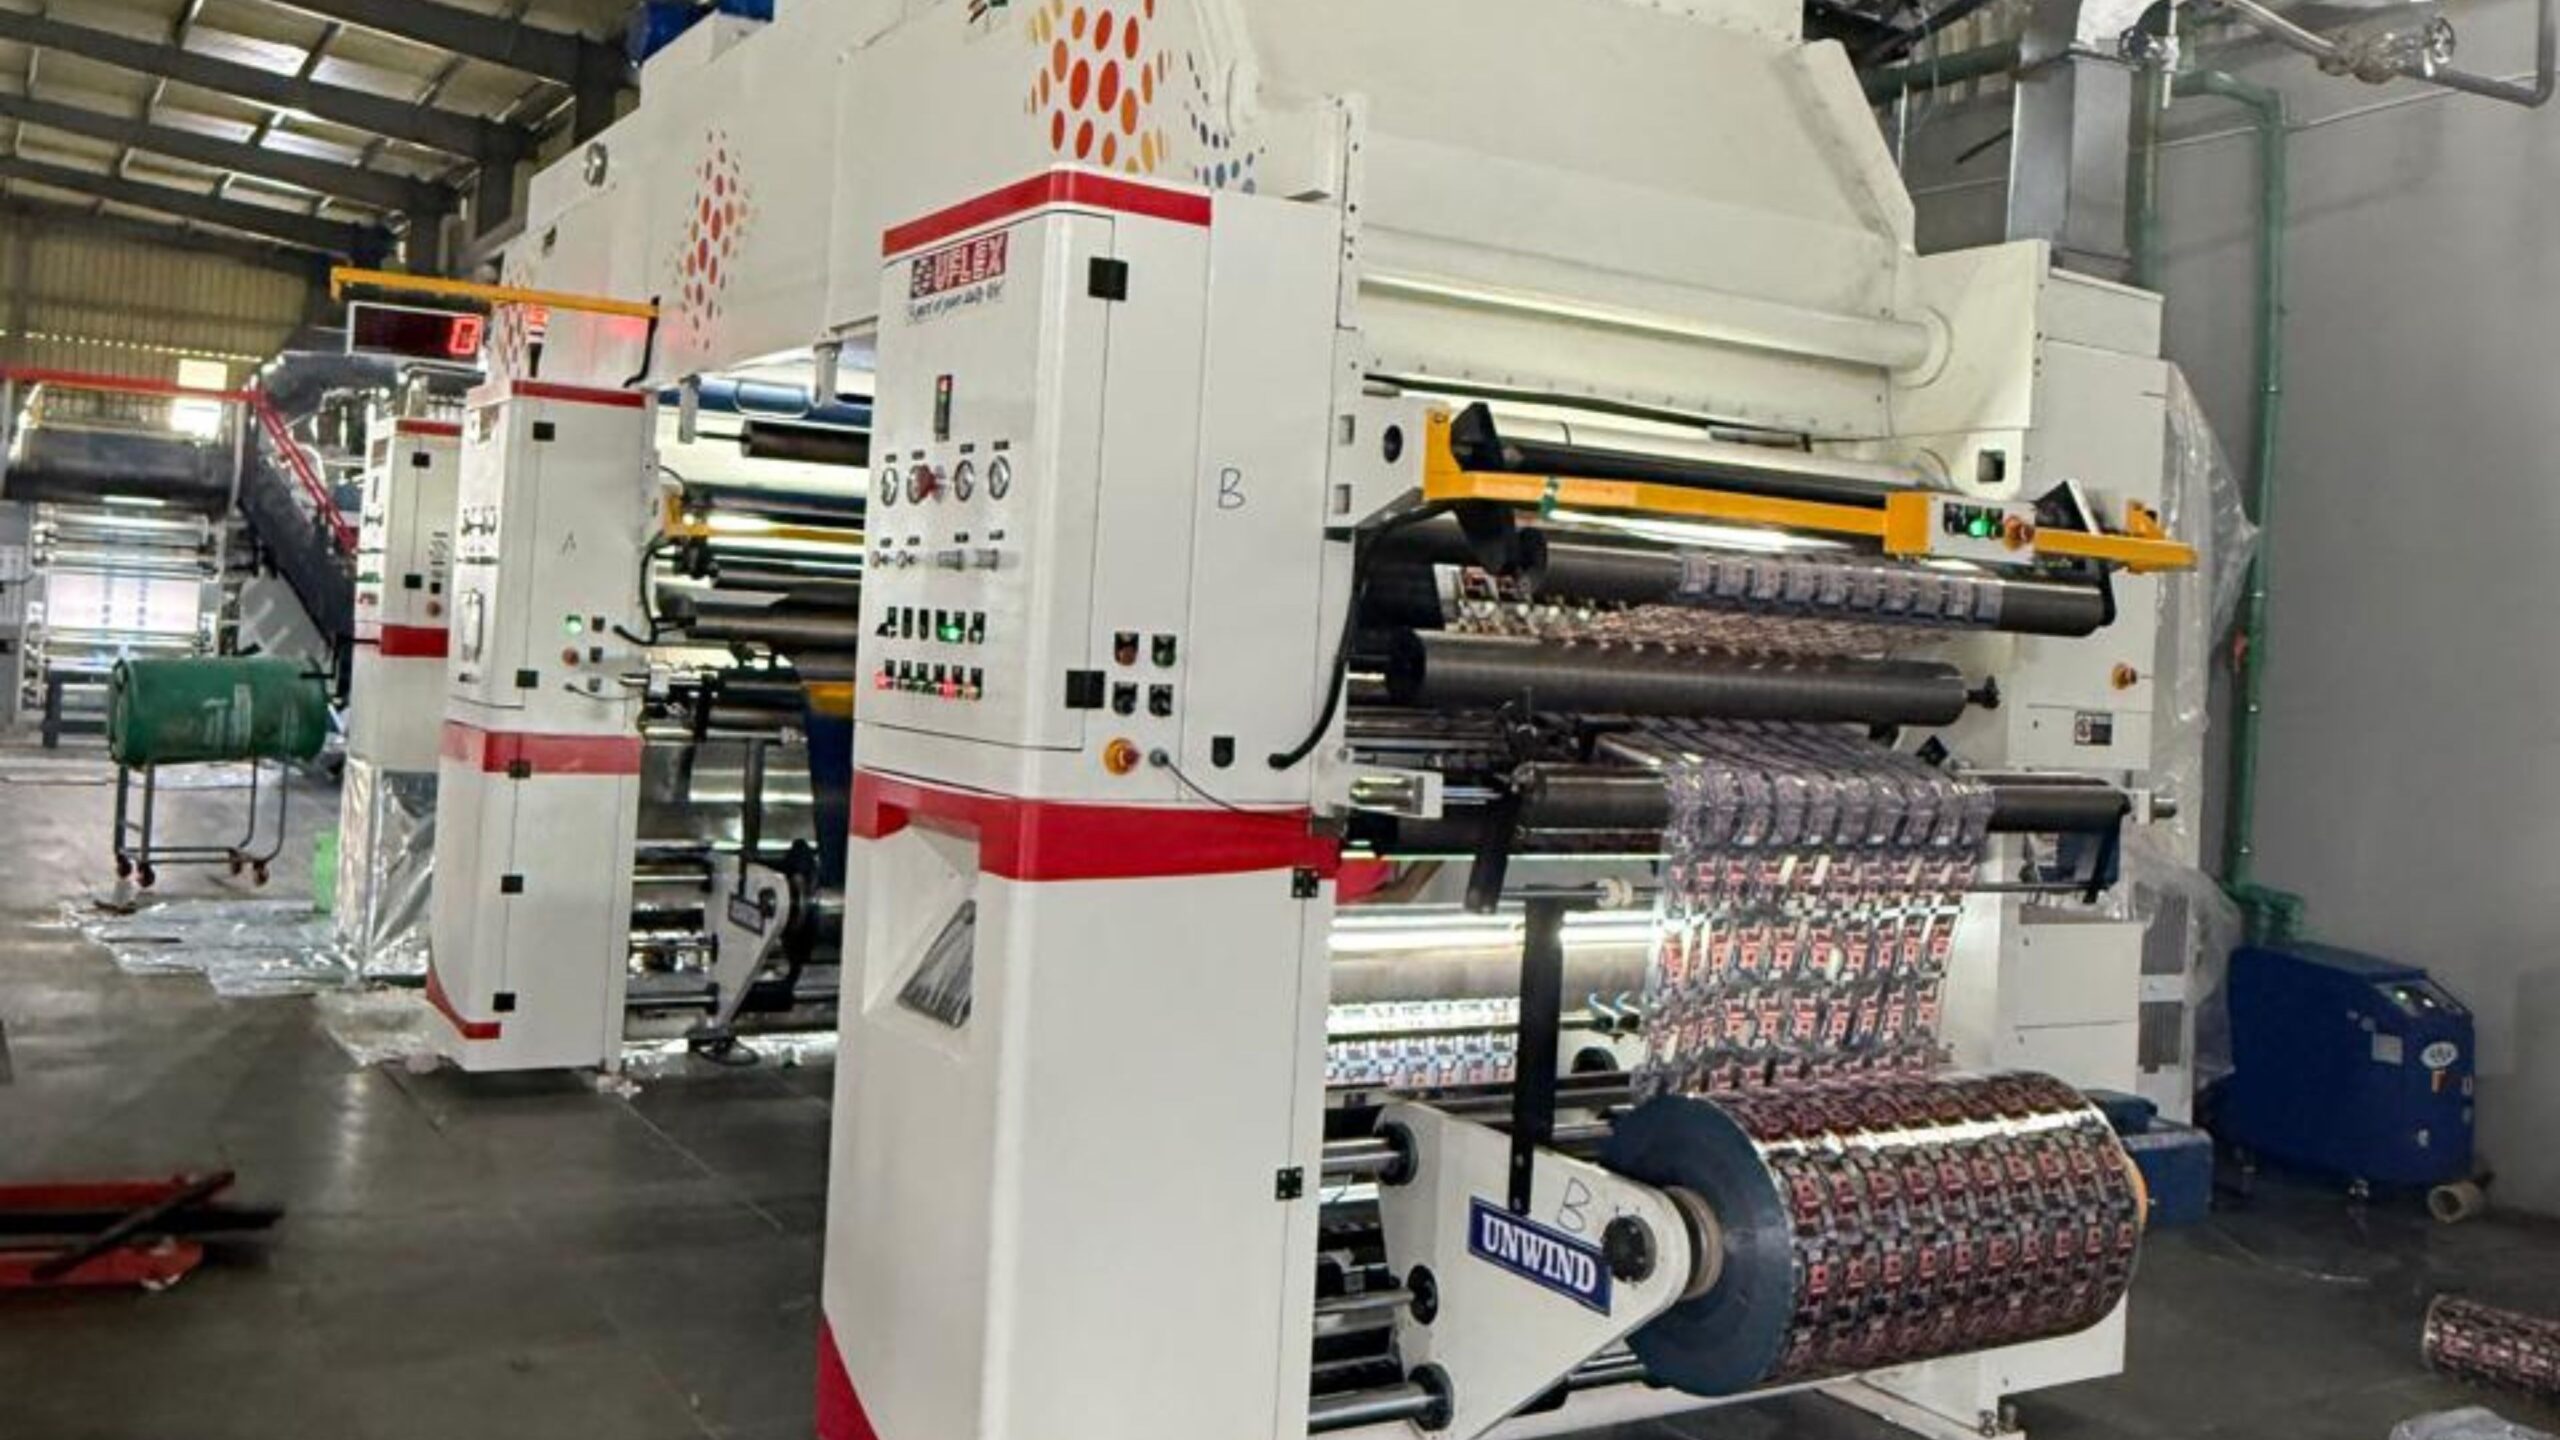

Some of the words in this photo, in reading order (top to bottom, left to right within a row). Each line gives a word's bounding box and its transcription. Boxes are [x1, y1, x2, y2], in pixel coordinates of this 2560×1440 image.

[935, 234, 1005, 293] UFLEX
[450, 318, 479, 355] 0
[1218, 467, 1246, 509] B
[1557, 1176, 1592, 1233] B
[1481, 1213, 1597, 1293] UNWIND
